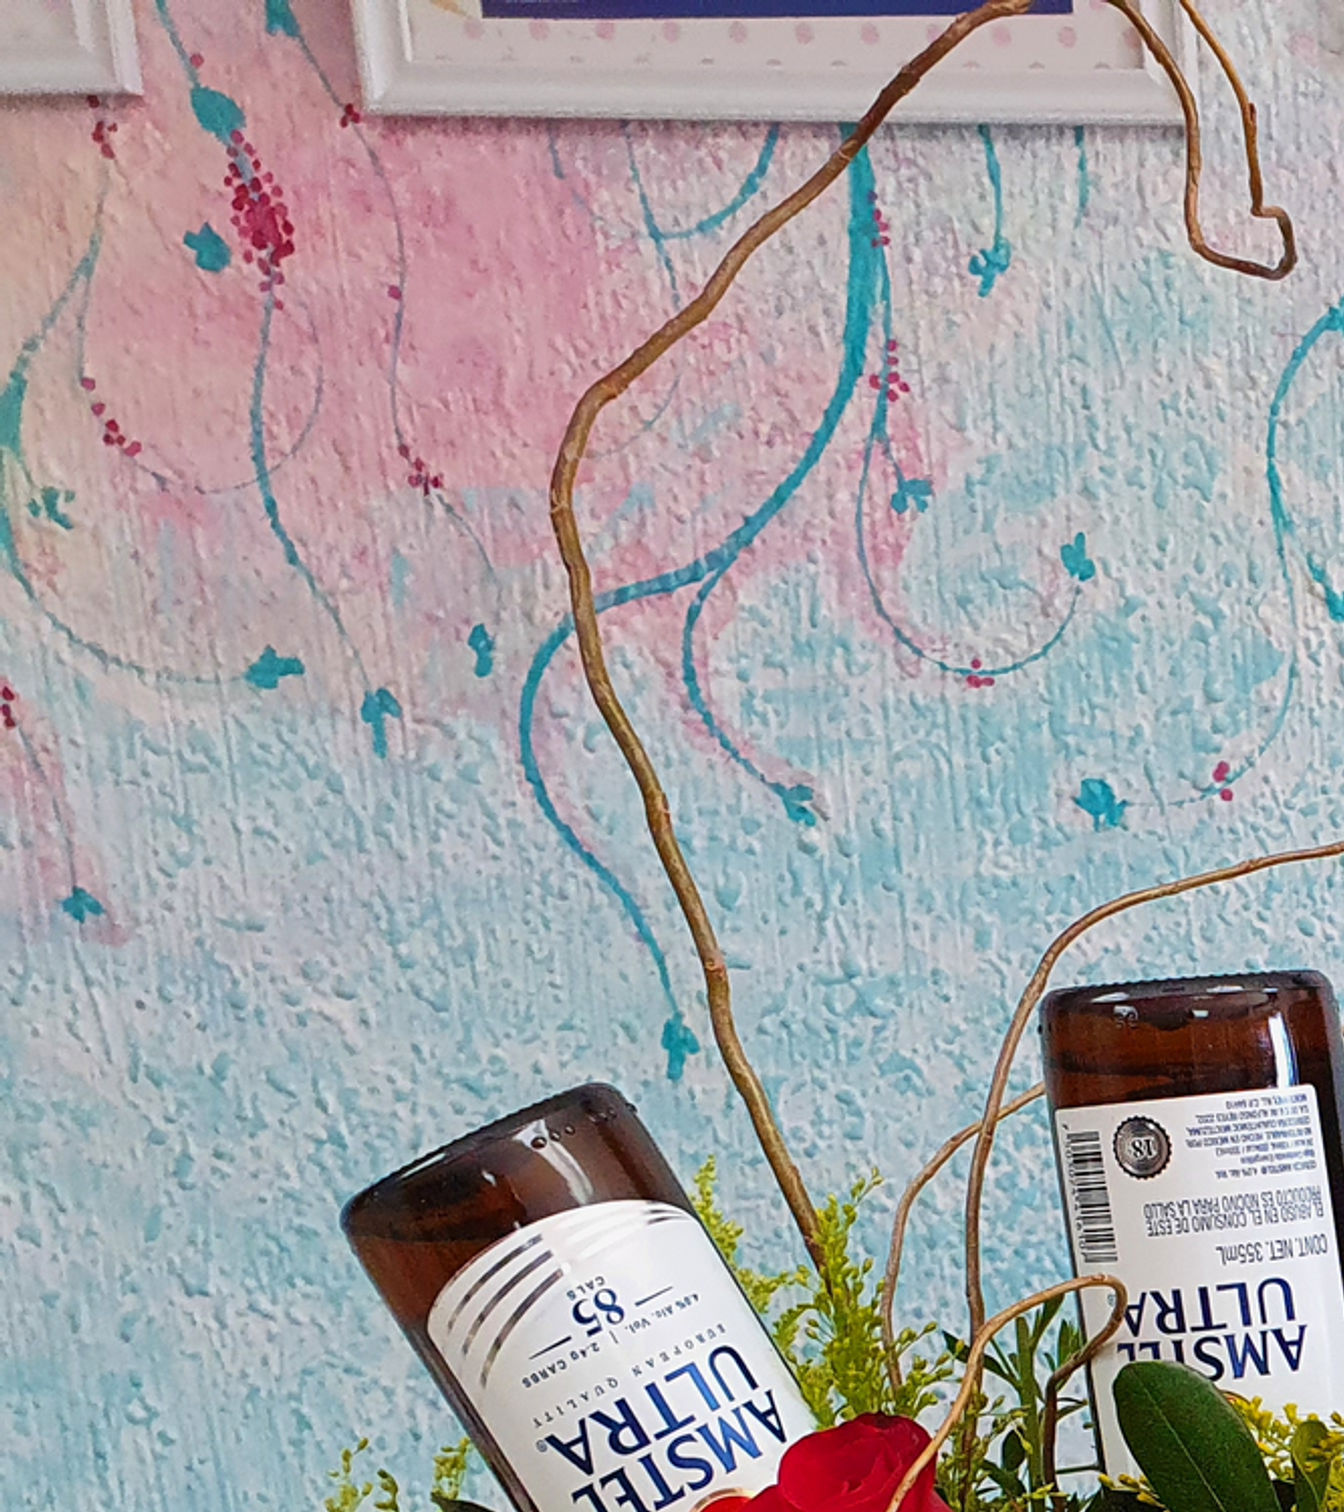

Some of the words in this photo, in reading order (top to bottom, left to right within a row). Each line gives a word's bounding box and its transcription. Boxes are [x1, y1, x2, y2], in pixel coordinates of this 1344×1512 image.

[1175, 1199, 1190, 1215] LA
[1191, 1197, 1219, 1214] PARA
[1221, 1193, 1259, 1211] NOCIVO
[1260, 1190, 1274, 1206] ES
[1143, 1201, 1175, 1219] SALUD
[1247, 1208, 1262, 1224] EL
[1263, 1206, 1279, 1223] EN
[1146, 1218, 1172, 1236] ESTE
[1173, 1216, 1189, 1234] DE
[1191, 1208, 1246, 1232] CONSUMO
[1215, 1241, 1263, 1266] 355mL
[566, 1276, 605, 1301] CALS
[572, 1288, 624, 1337] 85
[631, 1323, 726, 1377] EUROPEAN
[532, 1377, 618, 1429] QUALITY
